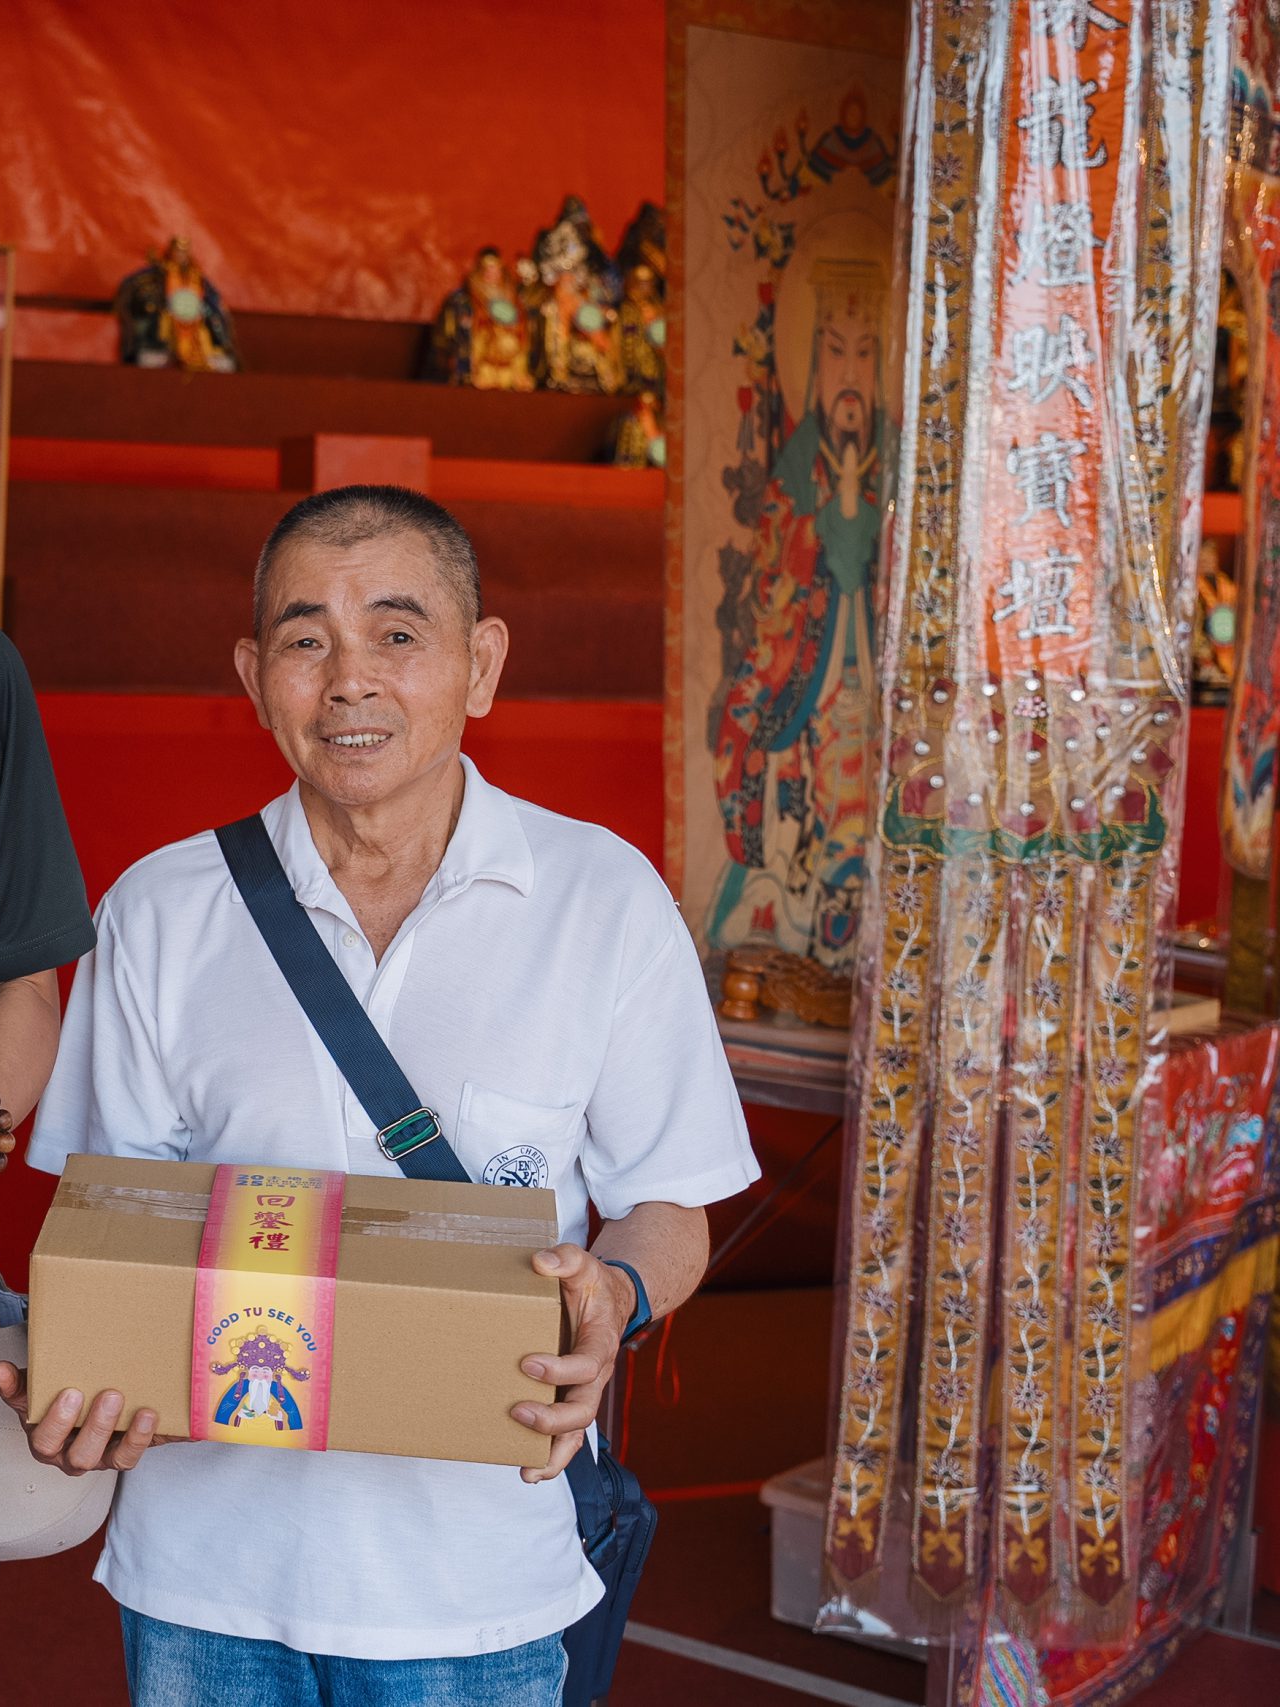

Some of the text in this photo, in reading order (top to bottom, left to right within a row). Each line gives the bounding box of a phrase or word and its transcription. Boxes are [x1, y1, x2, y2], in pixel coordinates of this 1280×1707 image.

[496, 1147, 545, 1169] IN CHRIST
[206, 1307, 318, 1352] GOOD TU SEE YOU
